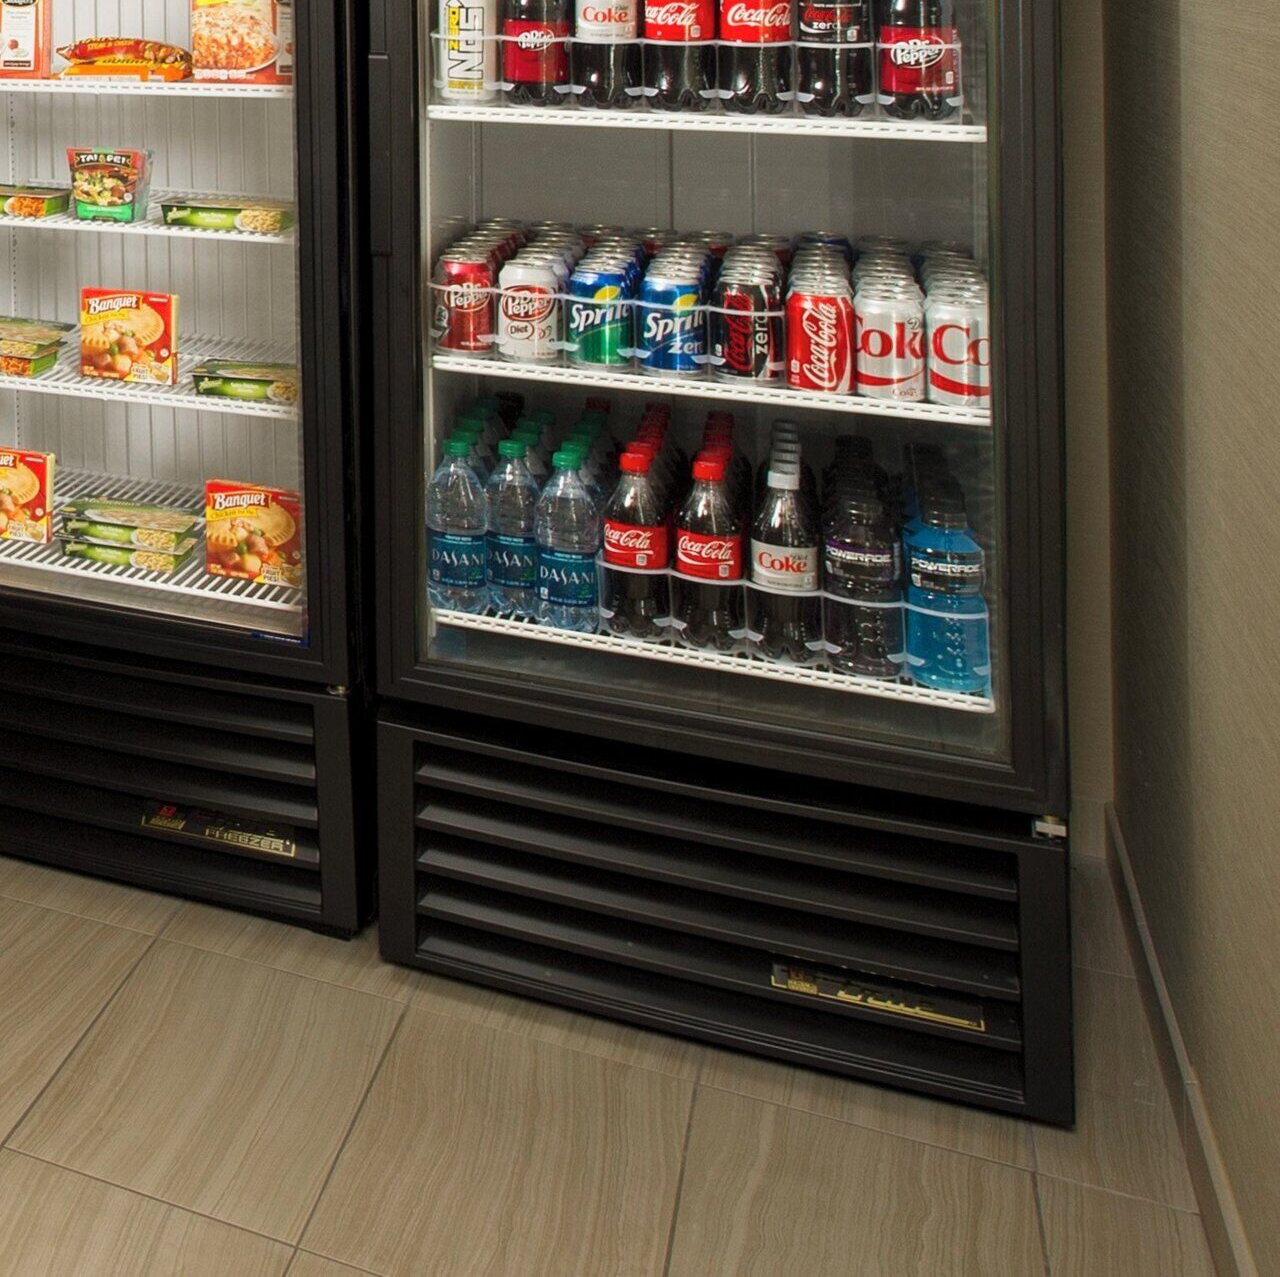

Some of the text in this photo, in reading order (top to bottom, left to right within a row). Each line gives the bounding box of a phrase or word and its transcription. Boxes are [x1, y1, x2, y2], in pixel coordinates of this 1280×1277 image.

[582, 5, 628, 23] Coke
[727, 2, 791, 27] Coca-Cola
[812, 21, 842, 31] zero
[894, 42, 940, 65] Pepper
[79, 153, 98, 163] TAI
[88, 296, 139, 315] Banquet
[507, 294, 551, 316] Pepper
[569, 300, 630, 333] Sprite
[510, 324, 529, 335] Diet
[755, 309, 769, 355] zero
[802, 302, 838, 388] Coca-Cola
[214, 492, 267, 511] Banquet
[604, 524, 652, 549] Coca-Cola
[431, 548, 485, 567] DASANI
[678, 535, 734, 561] Coca-Cola
[825, 544, 892, 563] POWERADE
[758, 550, 808, 574] Coke
[911, 557, 982, 574] POWERADE
[539, 564, 595, 585] DASANI
